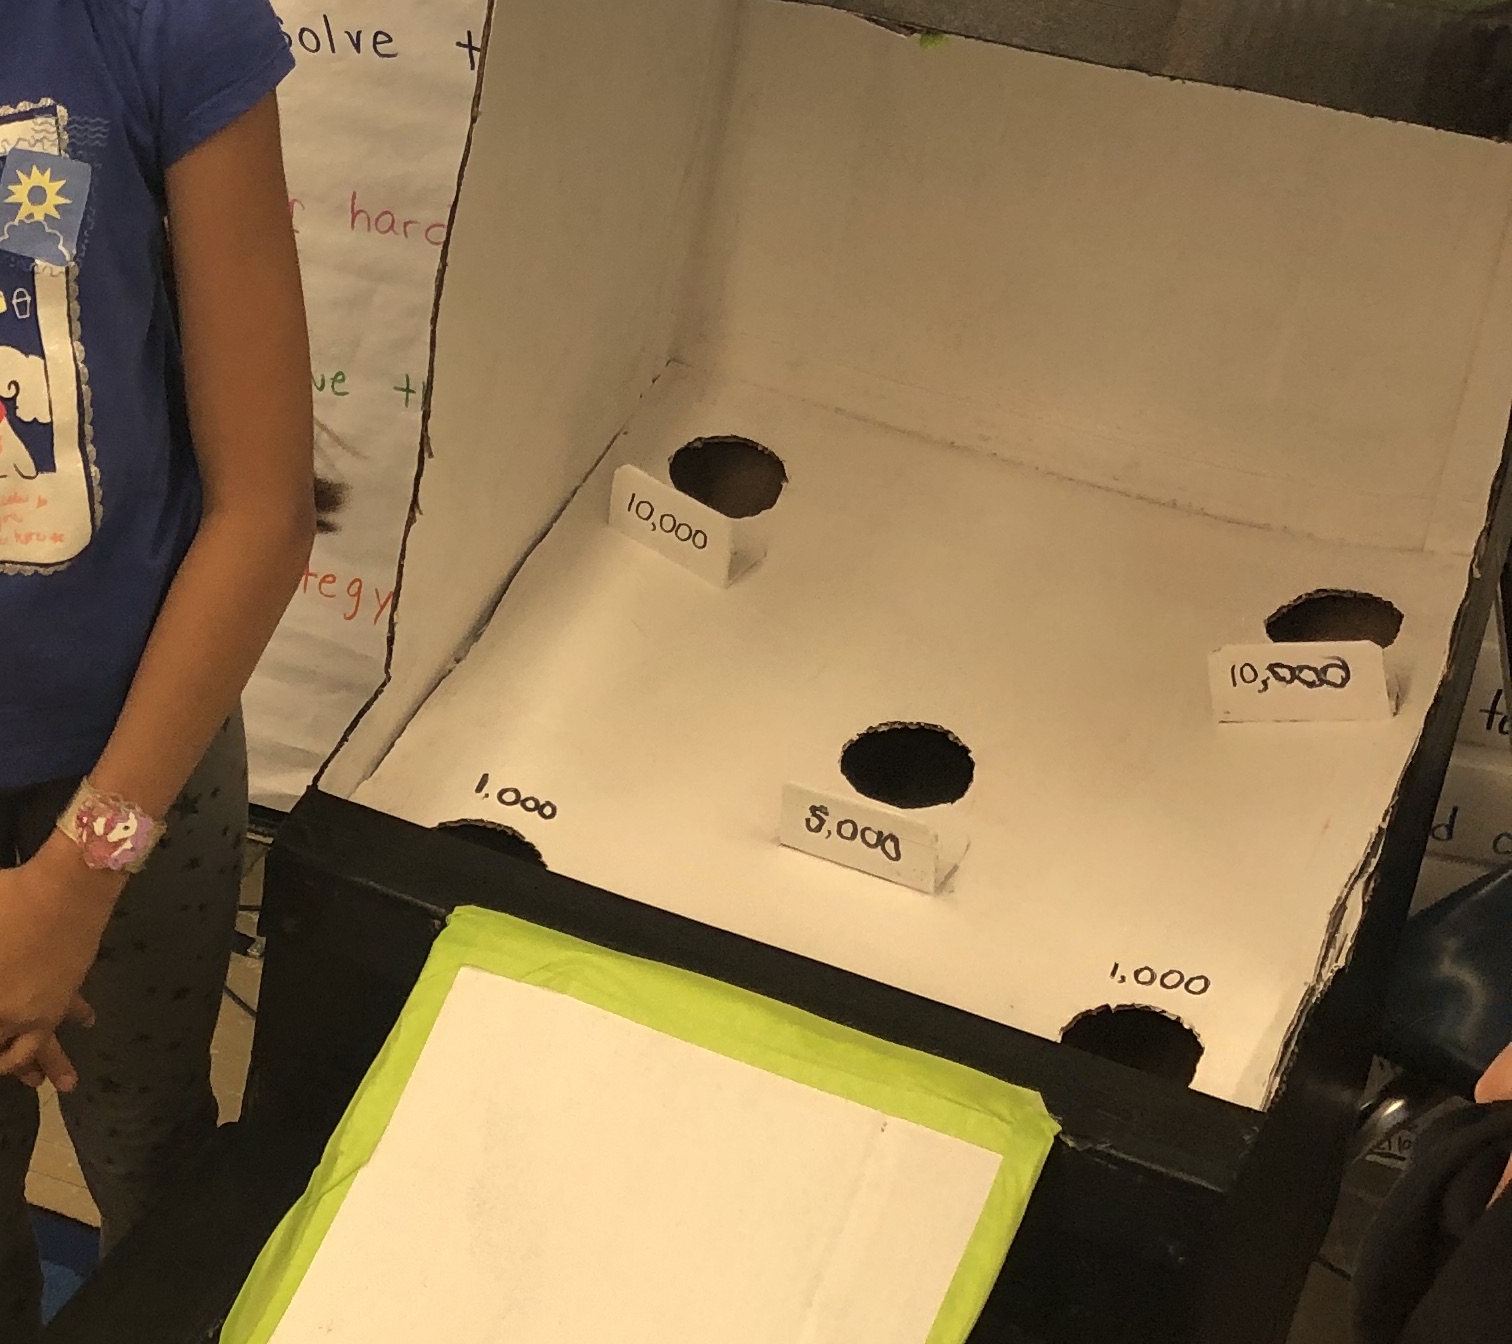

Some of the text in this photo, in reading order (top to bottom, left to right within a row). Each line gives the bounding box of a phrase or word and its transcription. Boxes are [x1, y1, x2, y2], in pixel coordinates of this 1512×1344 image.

[627, 492, 708, 550] 10,000
[1230, 655, 1351, 694] 10,000
[804, 804, 902, 862] 5,000
[1109, 961, 1211, 996] 1,000
